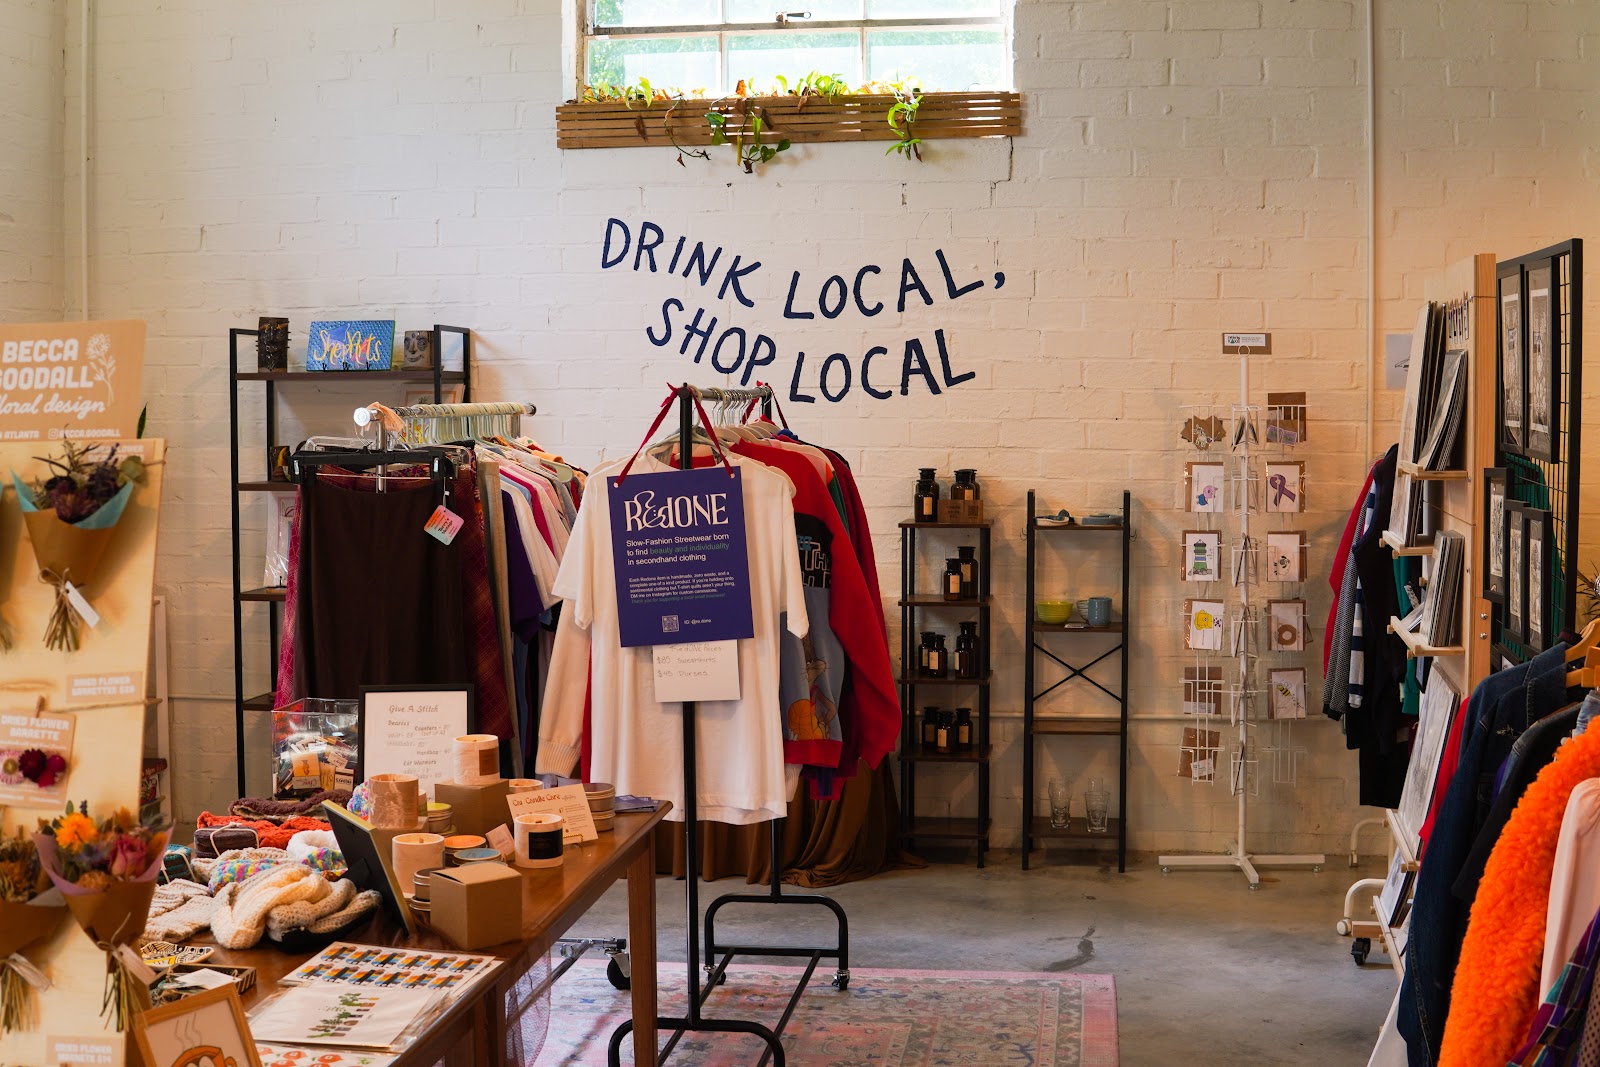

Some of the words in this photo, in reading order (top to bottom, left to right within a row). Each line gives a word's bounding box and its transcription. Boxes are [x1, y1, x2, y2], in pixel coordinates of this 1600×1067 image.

[601, 217, 762, 307] DRINK
[783, 249, 1006, 319] LOCAL,
[2, 338, 79, 363] BECCA
[646, 298, 776, 386] SHOP
[789, 328, 976, 403] LOCAL
[0, 366, 94, 390] OODALL
[0, 393, 43, 415] loral
[43, 392, 105, 420] design
[626, 538, 672, 547] Slow-Fashion
[674, 535, 711, 544] Streetwear
[650, 547, 673, 556] beauty
[690, 542, 730, 551] individuality
[636, 555, 677, 565] secondhand
[679, 553, 706, 562] clothing
[30, 716, 70, 730] FLOWER
